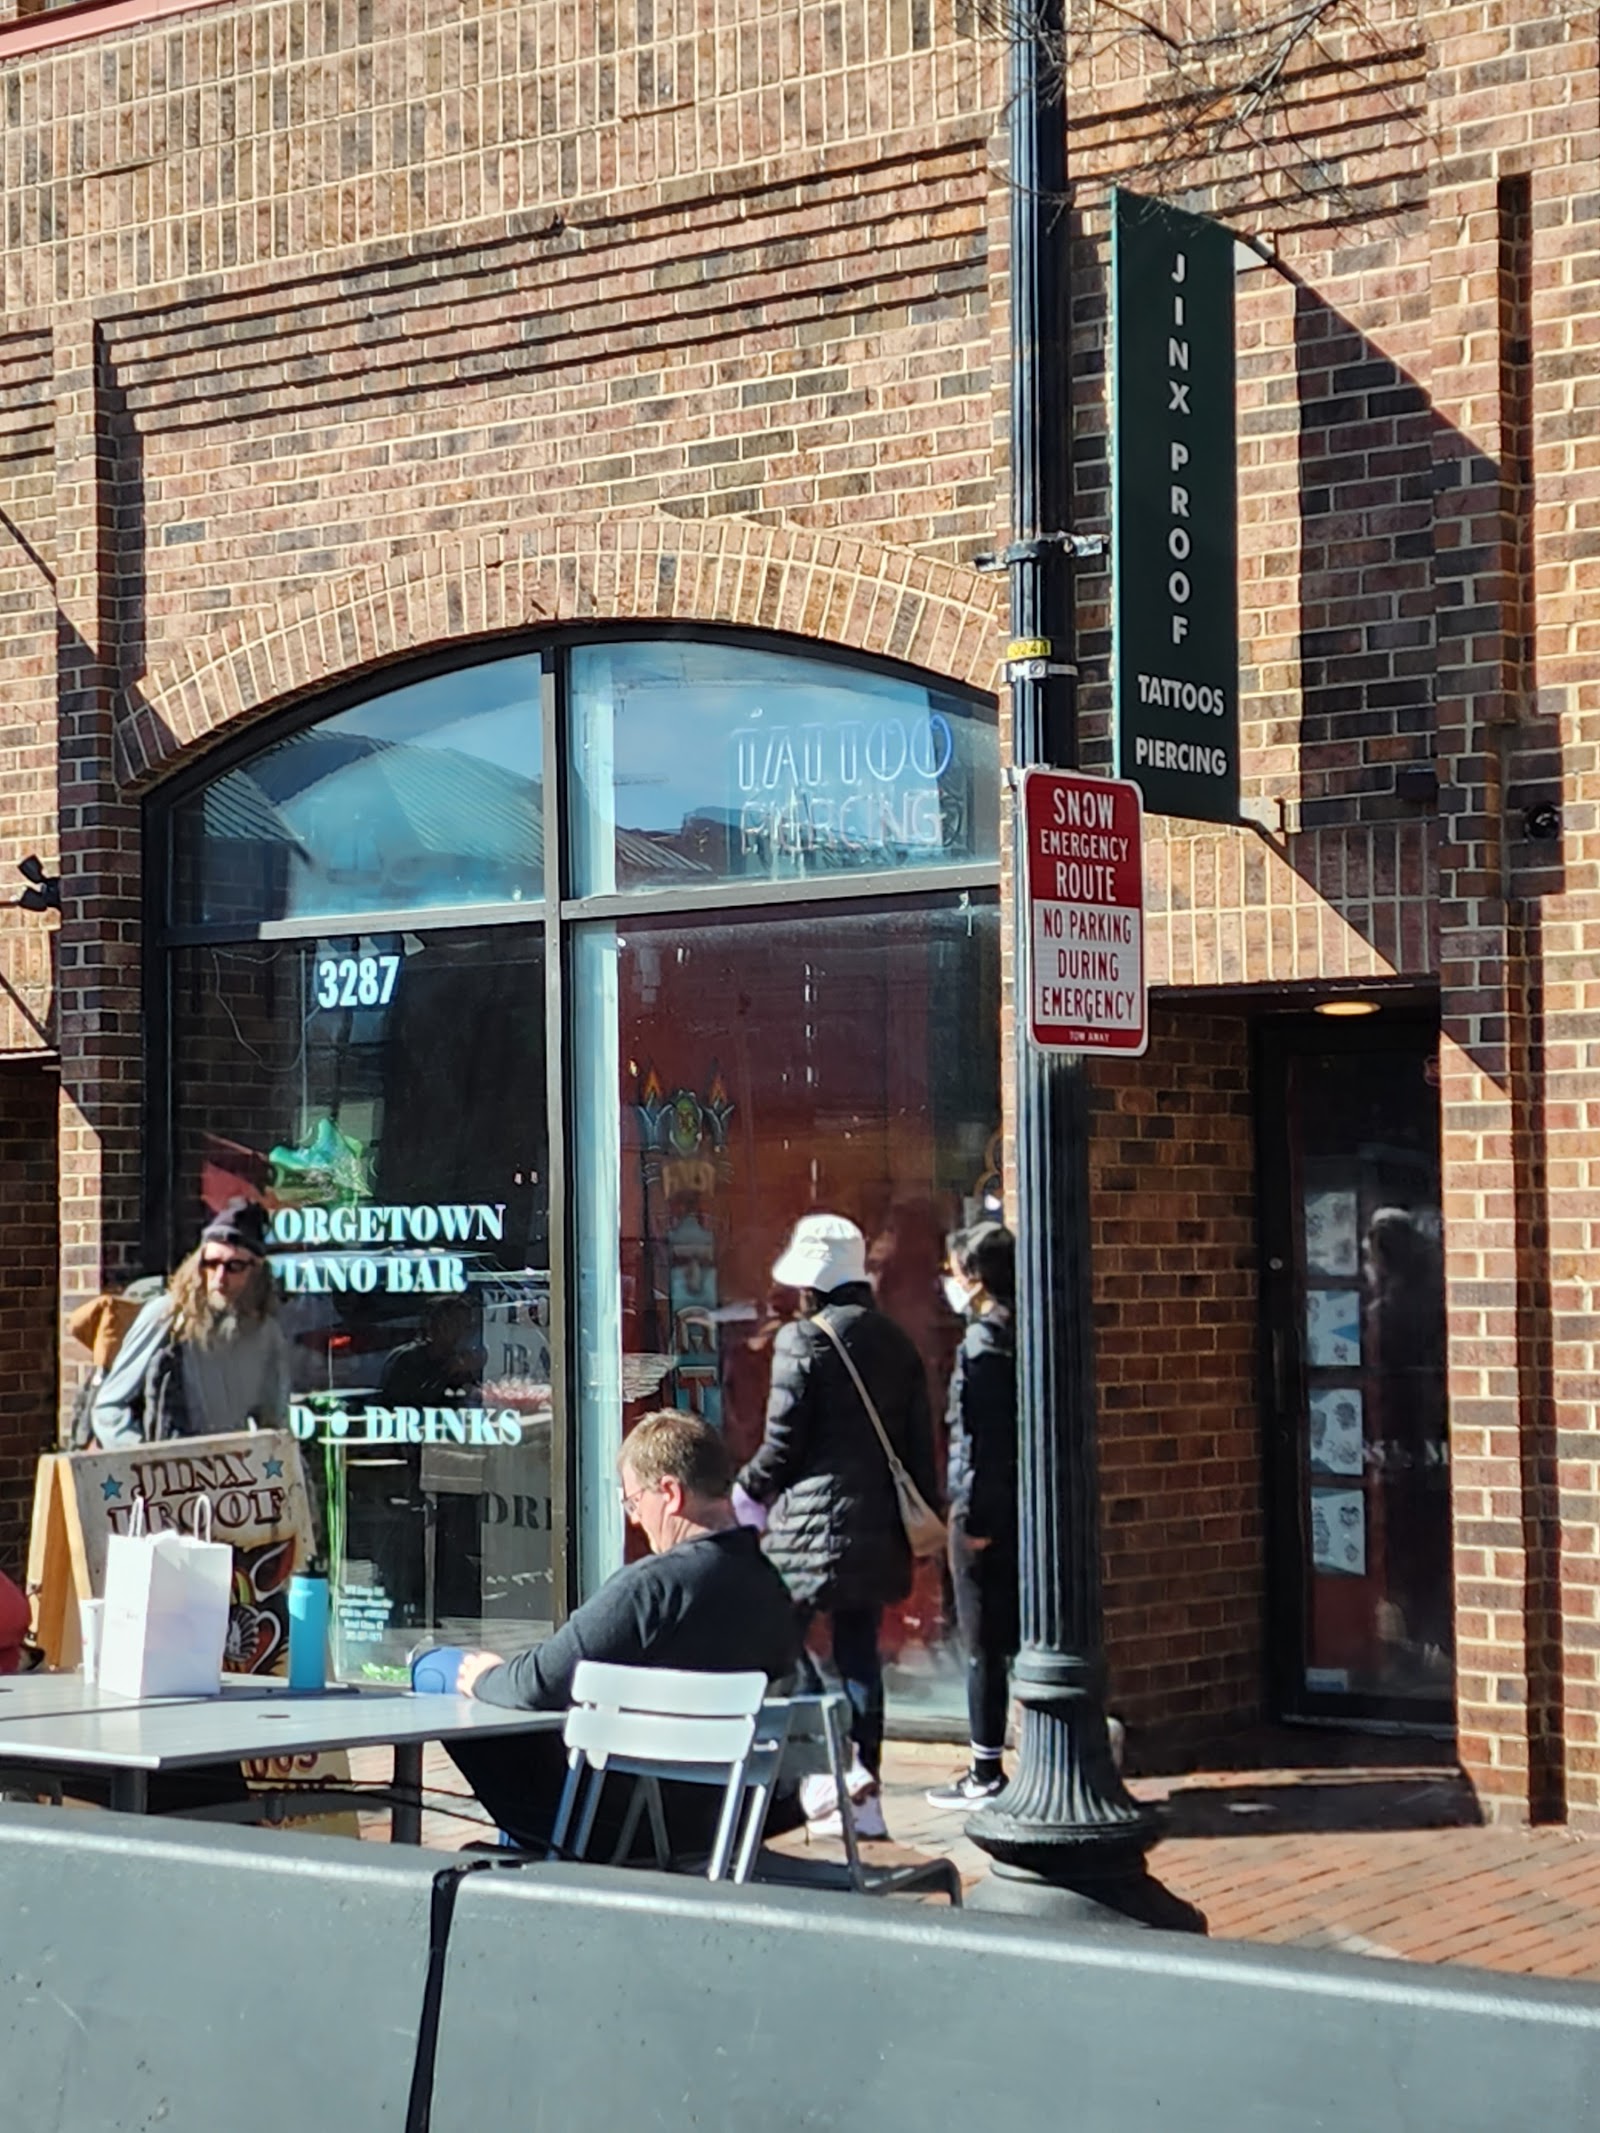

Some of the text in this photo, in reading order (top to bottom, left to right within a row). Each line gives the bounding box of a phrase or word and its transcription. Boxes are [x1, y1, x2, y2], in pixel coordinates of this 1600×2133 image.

[1168, 252, 1192, 645] JINX PROOF
[1137, 673, 1225, 717] TATTOOS
[731, 714, 953, 791] TATTOO
[1135, 736, 1228, 777] PIERCING
[1053, 787, 1115, 830] SNOW
[1040, 828, 1129, 862] EMERGENCY
[1056, 861, 1117, 902] ROUTE
[1043, 907, 1133, 944] NO PARKING
[318, 955, 401, 1009] 3287
[1057, 948, 1120, 981] DURING
[1041, 986, 1136, 1020] EMERGENCY
[385, 1257, 467, 1293] BAR
[364, 1406, 522, 1446] DRINKS
[130, 1449, 258, 1502] JINX
